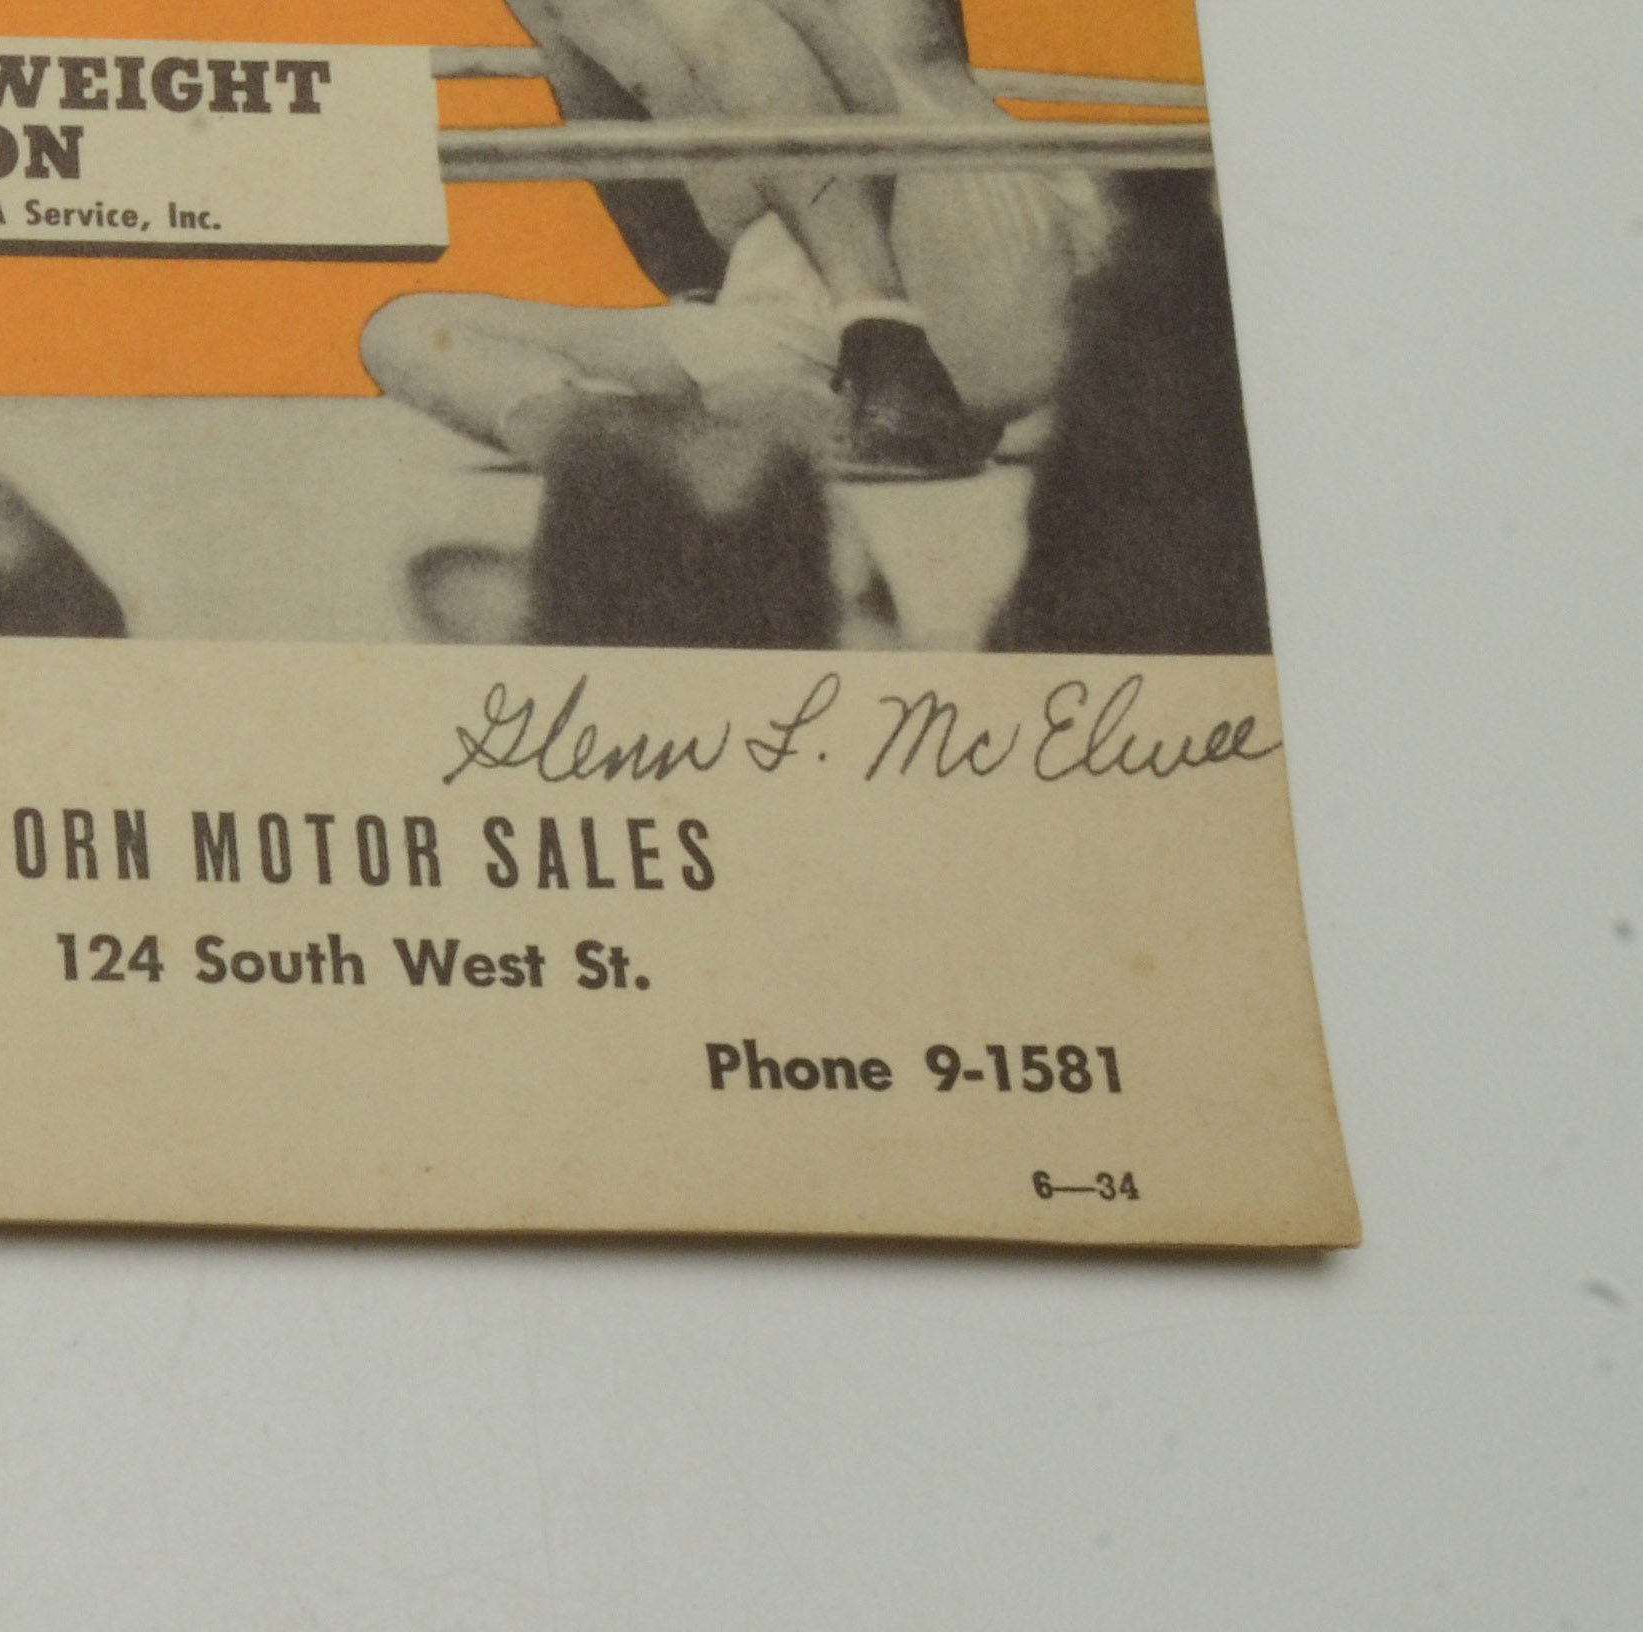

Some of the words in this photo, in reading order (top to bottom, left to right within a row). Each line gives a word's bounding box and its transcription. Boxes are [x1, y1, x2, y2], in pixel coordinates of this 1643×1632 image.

[24, 198, 151, 232] Service,
[168, 201, 222, 231] Inc.
[441, 674, 731, 786] Glenn
[191, 810, 442, 888] MOTOR
[482, 815, 716, 892] SALES
[56, 932, 165, 983] 124
[194, 932, 366, 986] South
[392, 937, 546, 988] West
[574, 939, 651, 991] St.
[705, 1038, 893, 1093] Phone
[924, 1043, 1122, 1095] 9-1581
